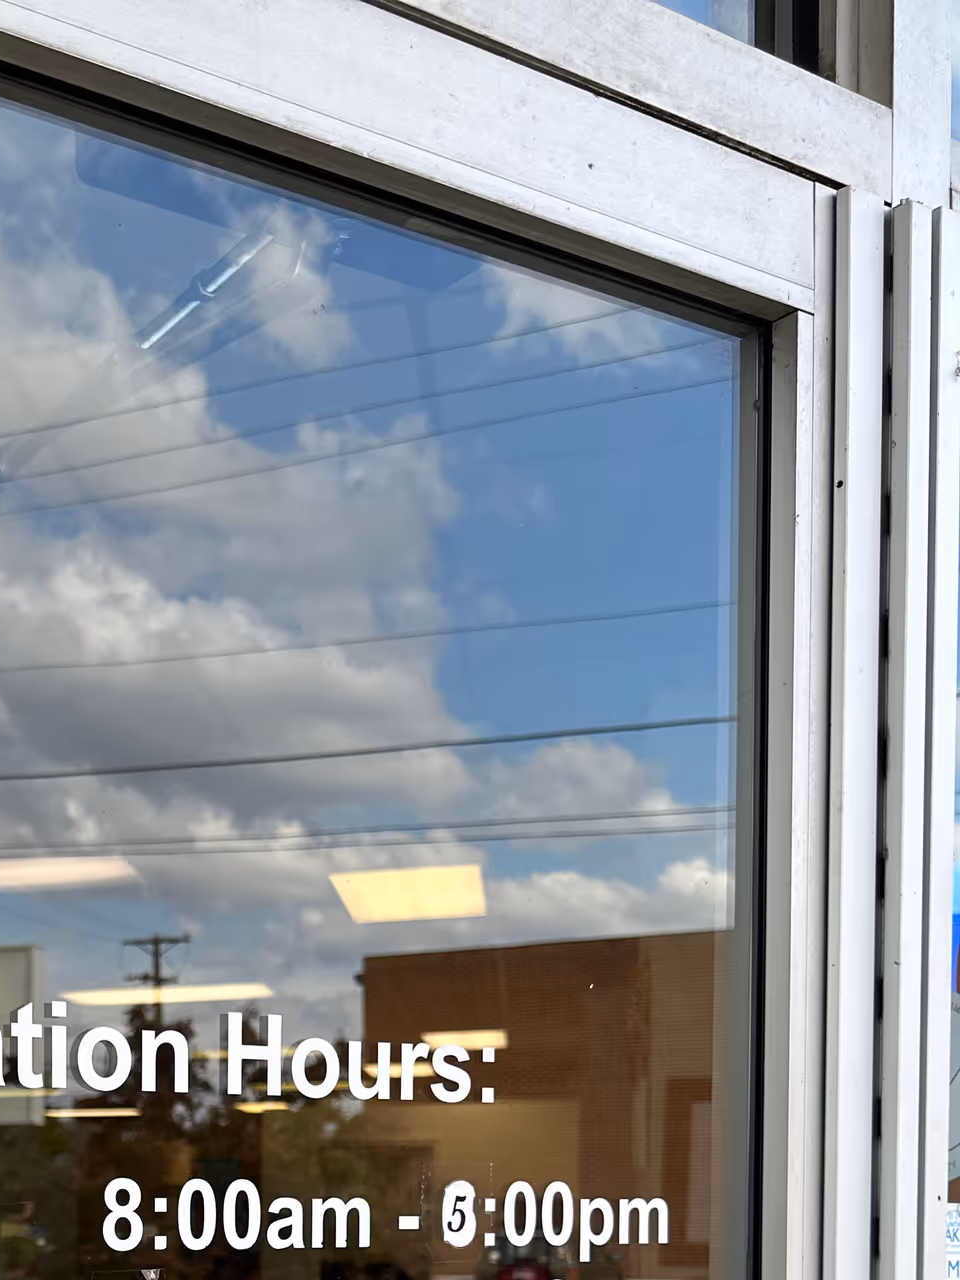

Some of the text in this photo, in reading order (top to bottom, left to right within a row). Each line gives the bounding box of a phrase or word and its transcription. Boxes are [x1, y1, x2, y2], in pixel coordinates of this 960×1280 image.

[228, 1012, 494, 1106] Hours:
[103, 1178, 369, 1251] 8:00am
[399, 1217, 419, 1229] -
[443, 1181, 667, 1261] 5:00pm
